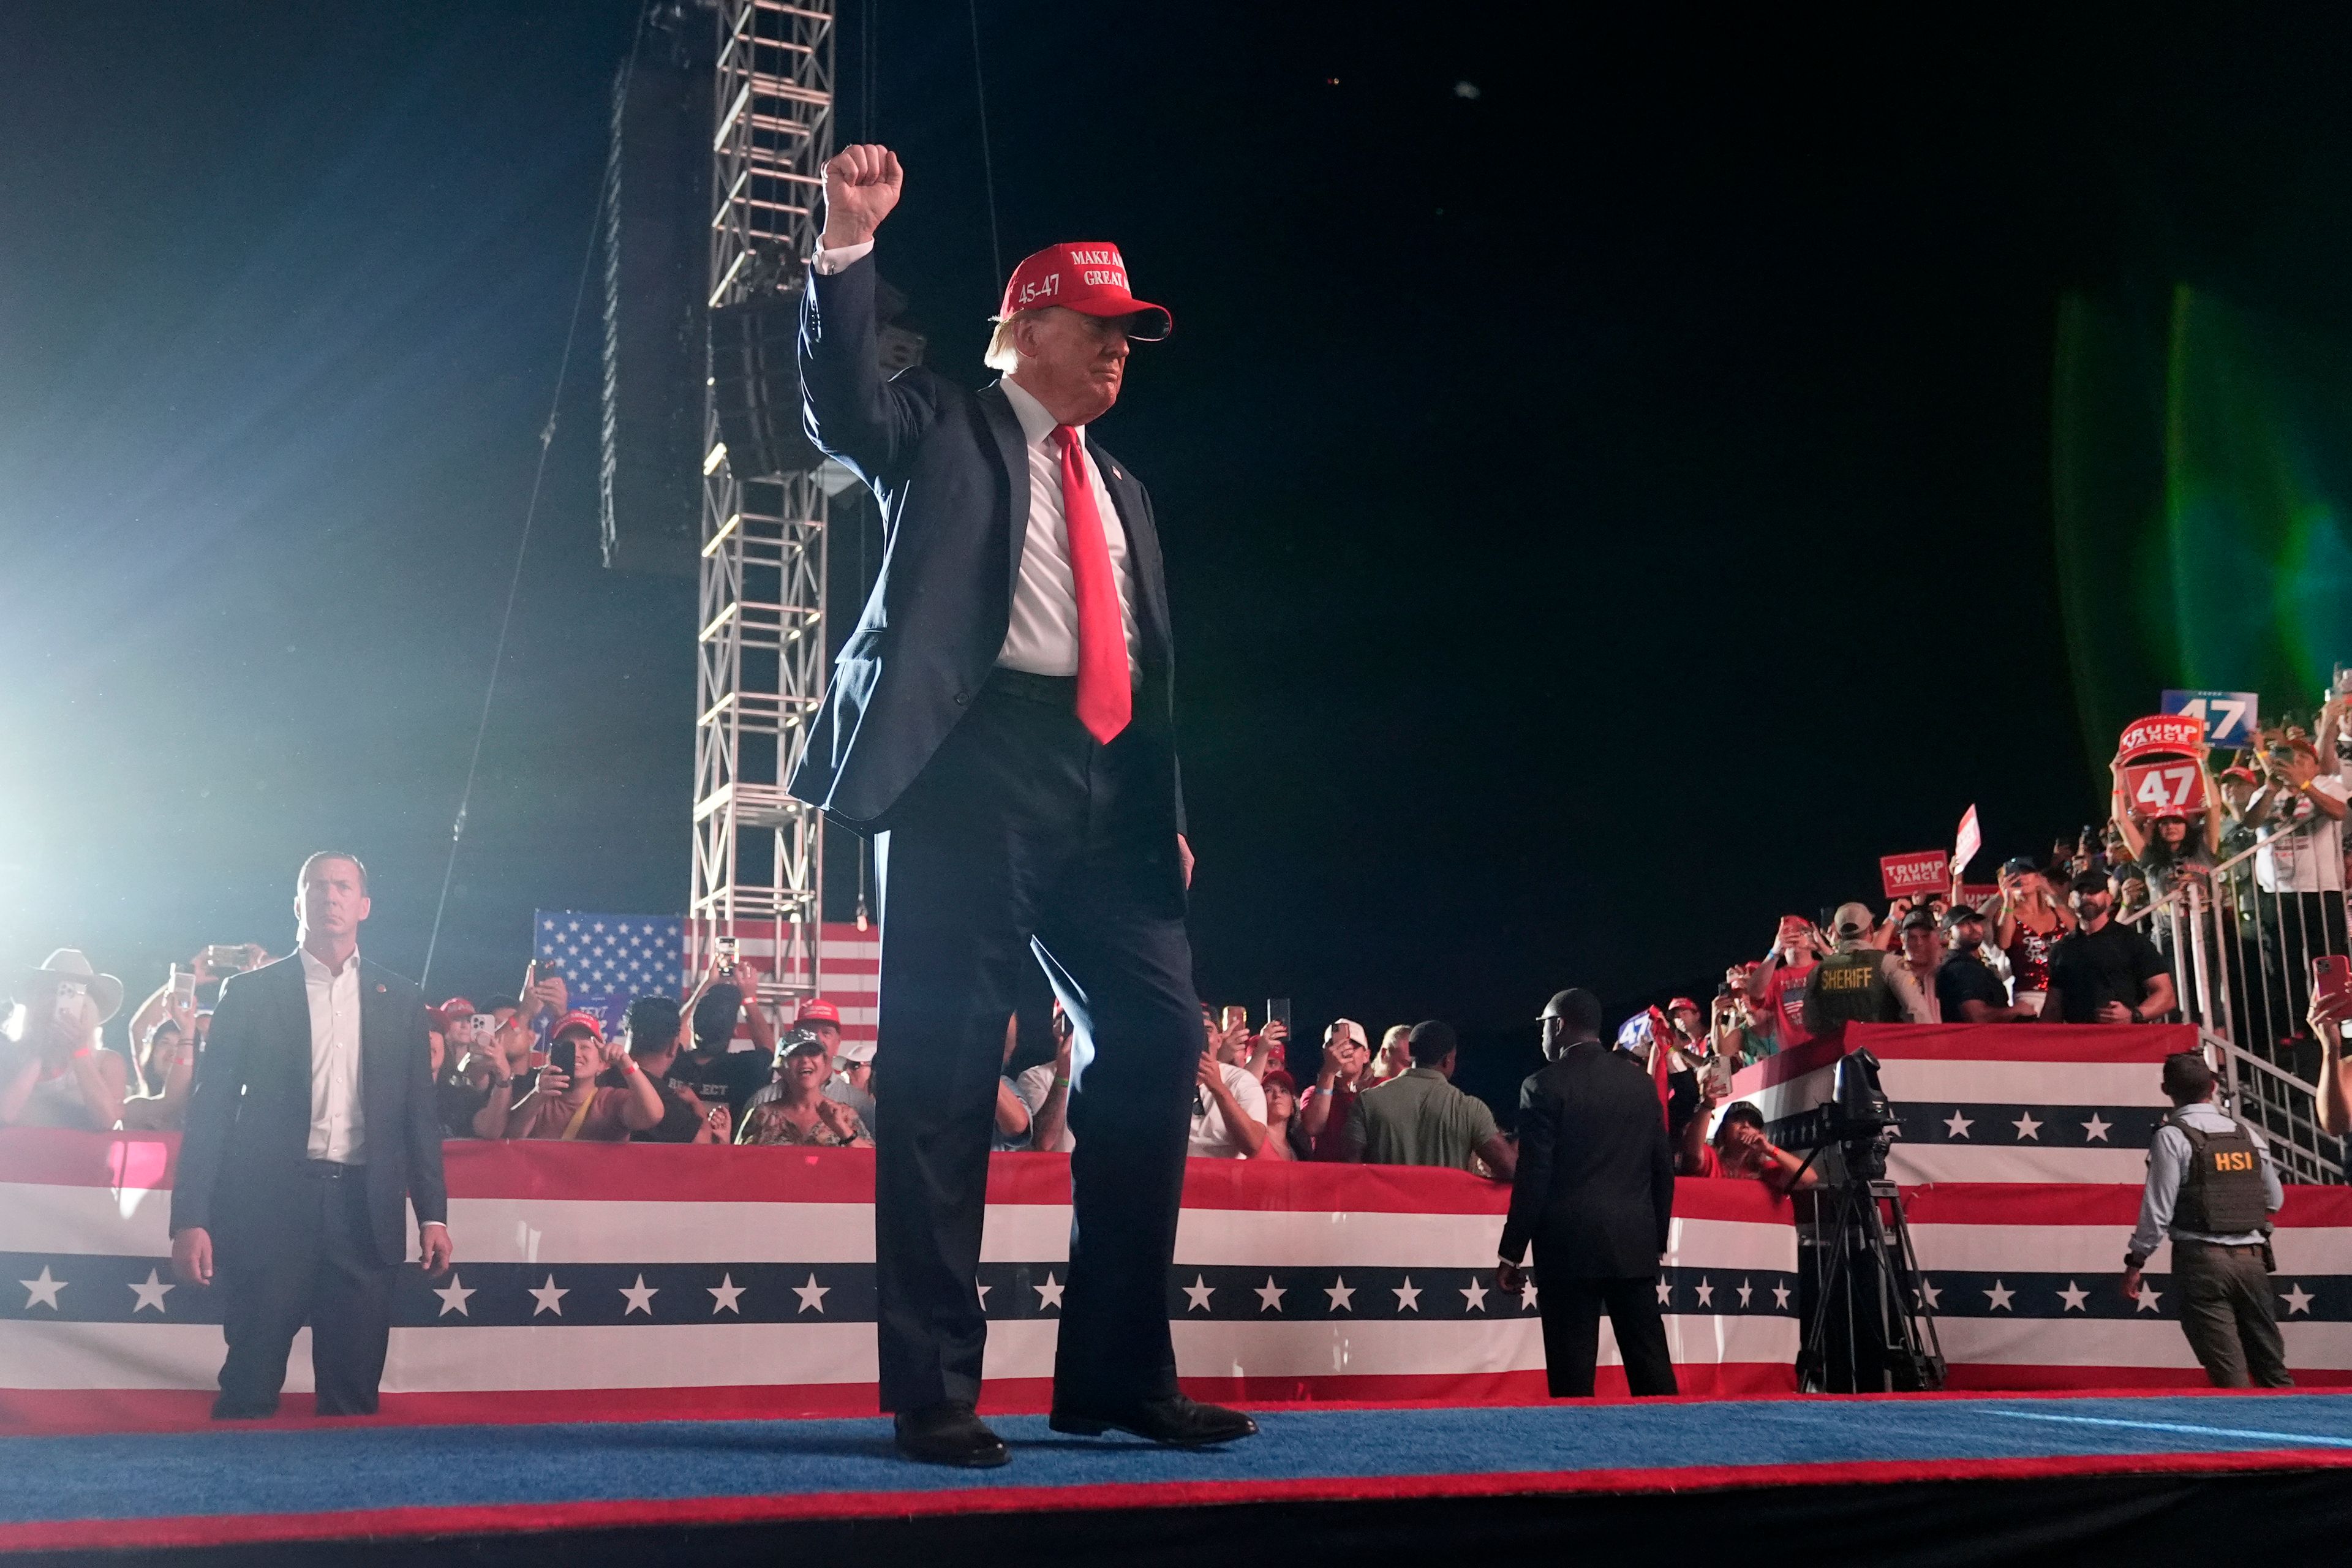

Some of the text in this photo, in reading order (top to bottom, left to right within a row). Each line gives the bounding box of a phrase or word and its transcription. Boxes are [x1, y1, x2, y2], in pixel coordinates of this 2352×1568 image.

[1071, 251, 1110, 265] MAKE
[1084, 270, 1123, 287] GREAT
[1019, 273, 1059, 304] 45-47
[2122, 723, 2198, 746] TRUMP
[2126, 732, 2188, 749] VANCE
[2136, 766, 2196, 808] 47
[1885, 860, 1944, 877] TRUMP
[1894, 870, 1939, 884] VANCE
[1822, 967, 1873, 990] SHERIFF
[1618, 1012, 1650, 1044] 47
[2215, 1152, 2253, 1171] HSI
